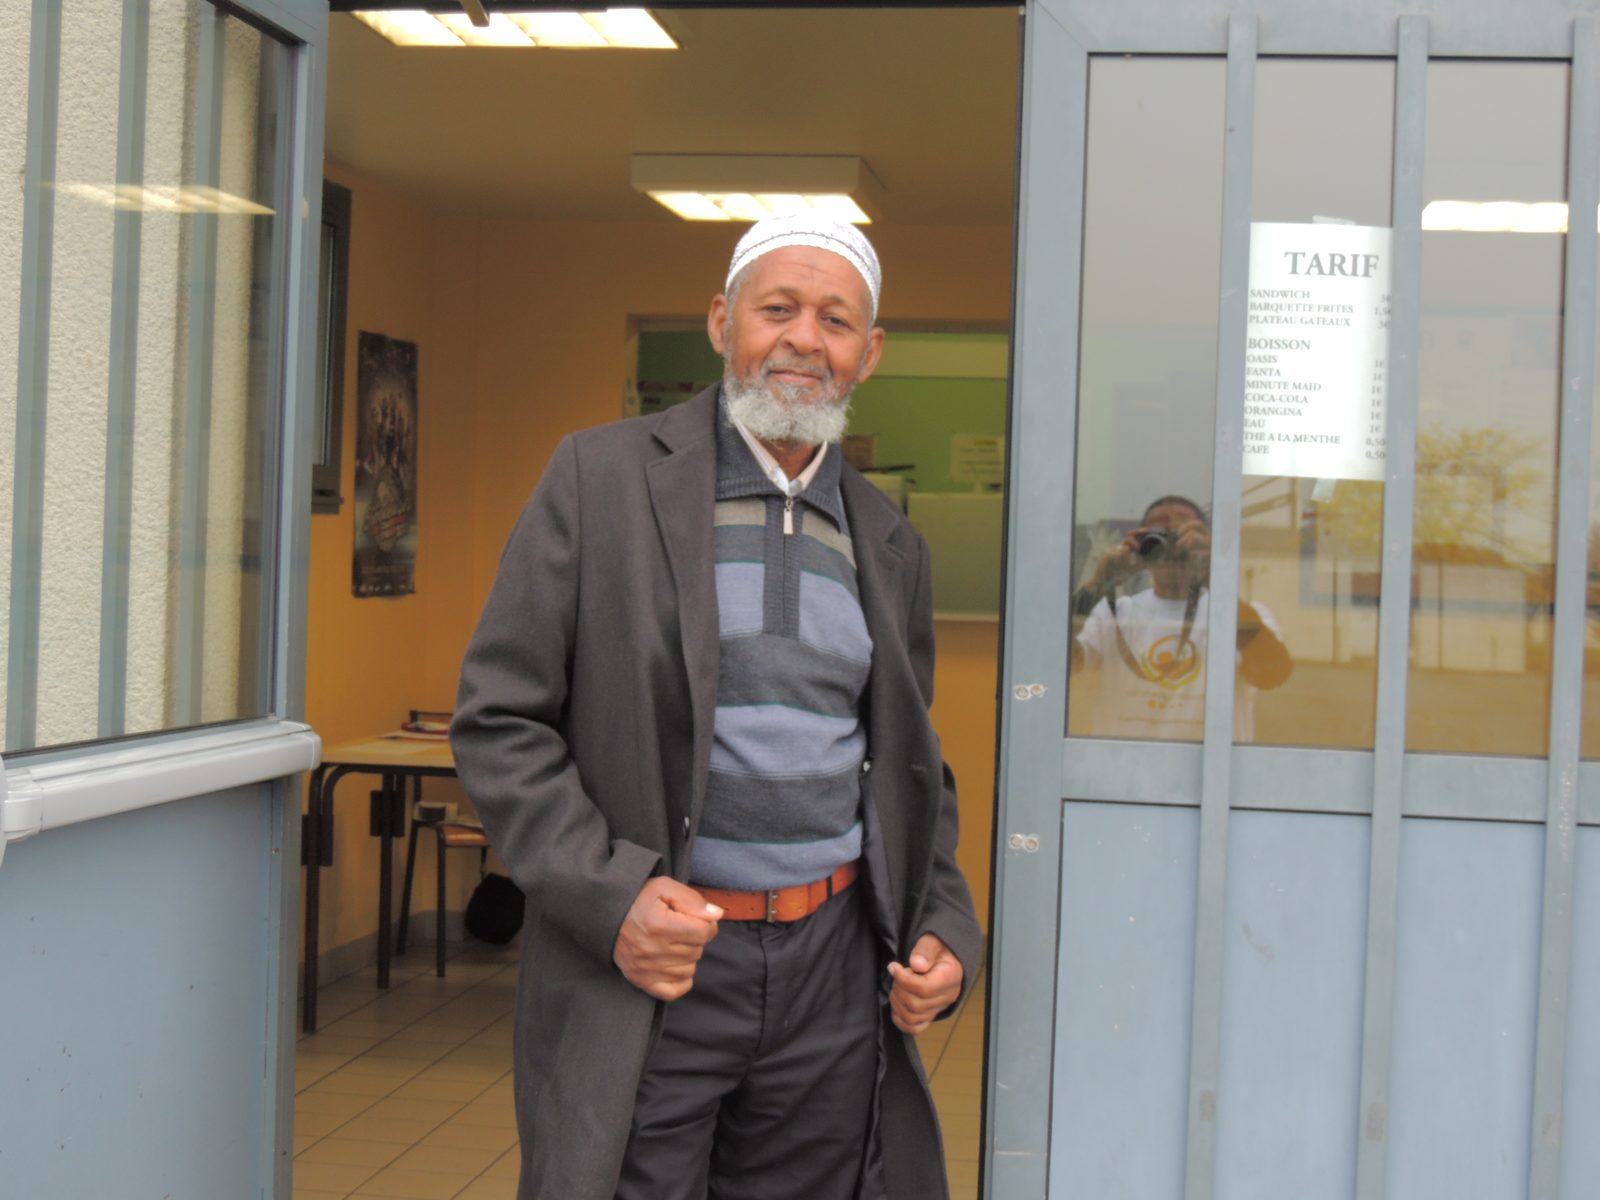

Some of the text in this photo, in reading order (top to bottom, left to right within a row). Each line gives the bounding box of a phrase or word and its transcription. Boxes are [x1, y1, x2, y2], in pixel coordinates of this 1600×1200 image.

[1284, 251, 1379, 278] TARIF
[1250, 289, 1310, 299] SANDWICH
[1249, 303, 1315, 313] BARQUETTE
[1317, 304, 1354, 313] FRITES
[1249, 315, 1296, 325] PLATEAU
[1300, 316, 1351, 327] GATEAUX
[1248, 338, 1311, 350] BOISSON
[1246, 354, 1278, 364] OASIS
[1246, 367, 1281, 377] FANTA
[1245, 380, 1289, 390] MINUTE
[1292, 381, 1322, 391] MAID
[1244, 393, 1308, 403] COCA-COLA
[1244, 406, 1302, 416] ORANGINA
[1243, 418, 1265, 428] EAU
[1243, 431, 1266, 441] THE
[1267, 432, 1275, 442] A
[1277, 433, 1290, 443] LA
[1293, 433, 1340, 444] MENTHE
[1242, 444, 1269, 454] CAFE
